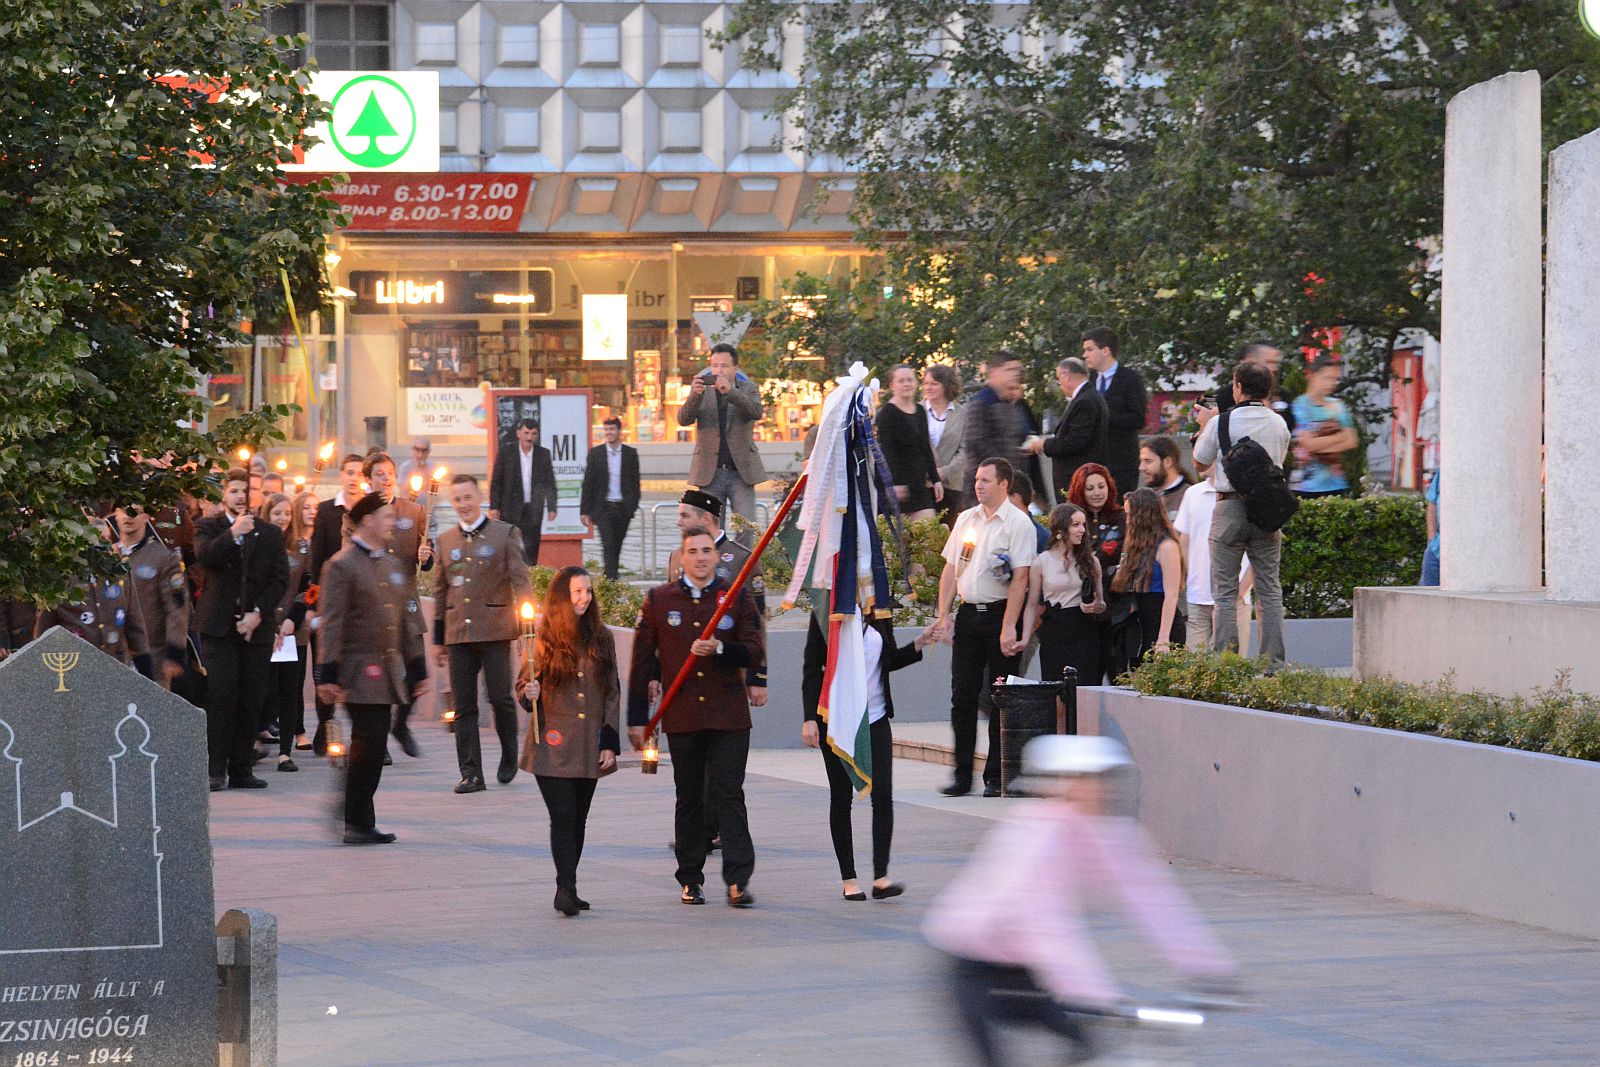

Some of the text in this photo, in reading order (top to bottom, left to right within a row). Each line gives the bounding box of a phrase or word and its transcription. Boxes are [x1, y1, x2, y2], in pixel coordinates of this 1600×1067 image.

[334, 183, 518, 202] MBAT 6.30-17.00
[389, 204, 513, 221] 8.00-13.00
[375, 280, 444, 304] Libri
[552, 434, 577, 461] MI
[2, 977, 165, 1003] HELYEN ÁLLT A
[0, 1008, 149, 1042] ZSINAGÓGA
[14, 1050, 60, 1067] 1864
[88, 1046, 134, 1065] 1944
